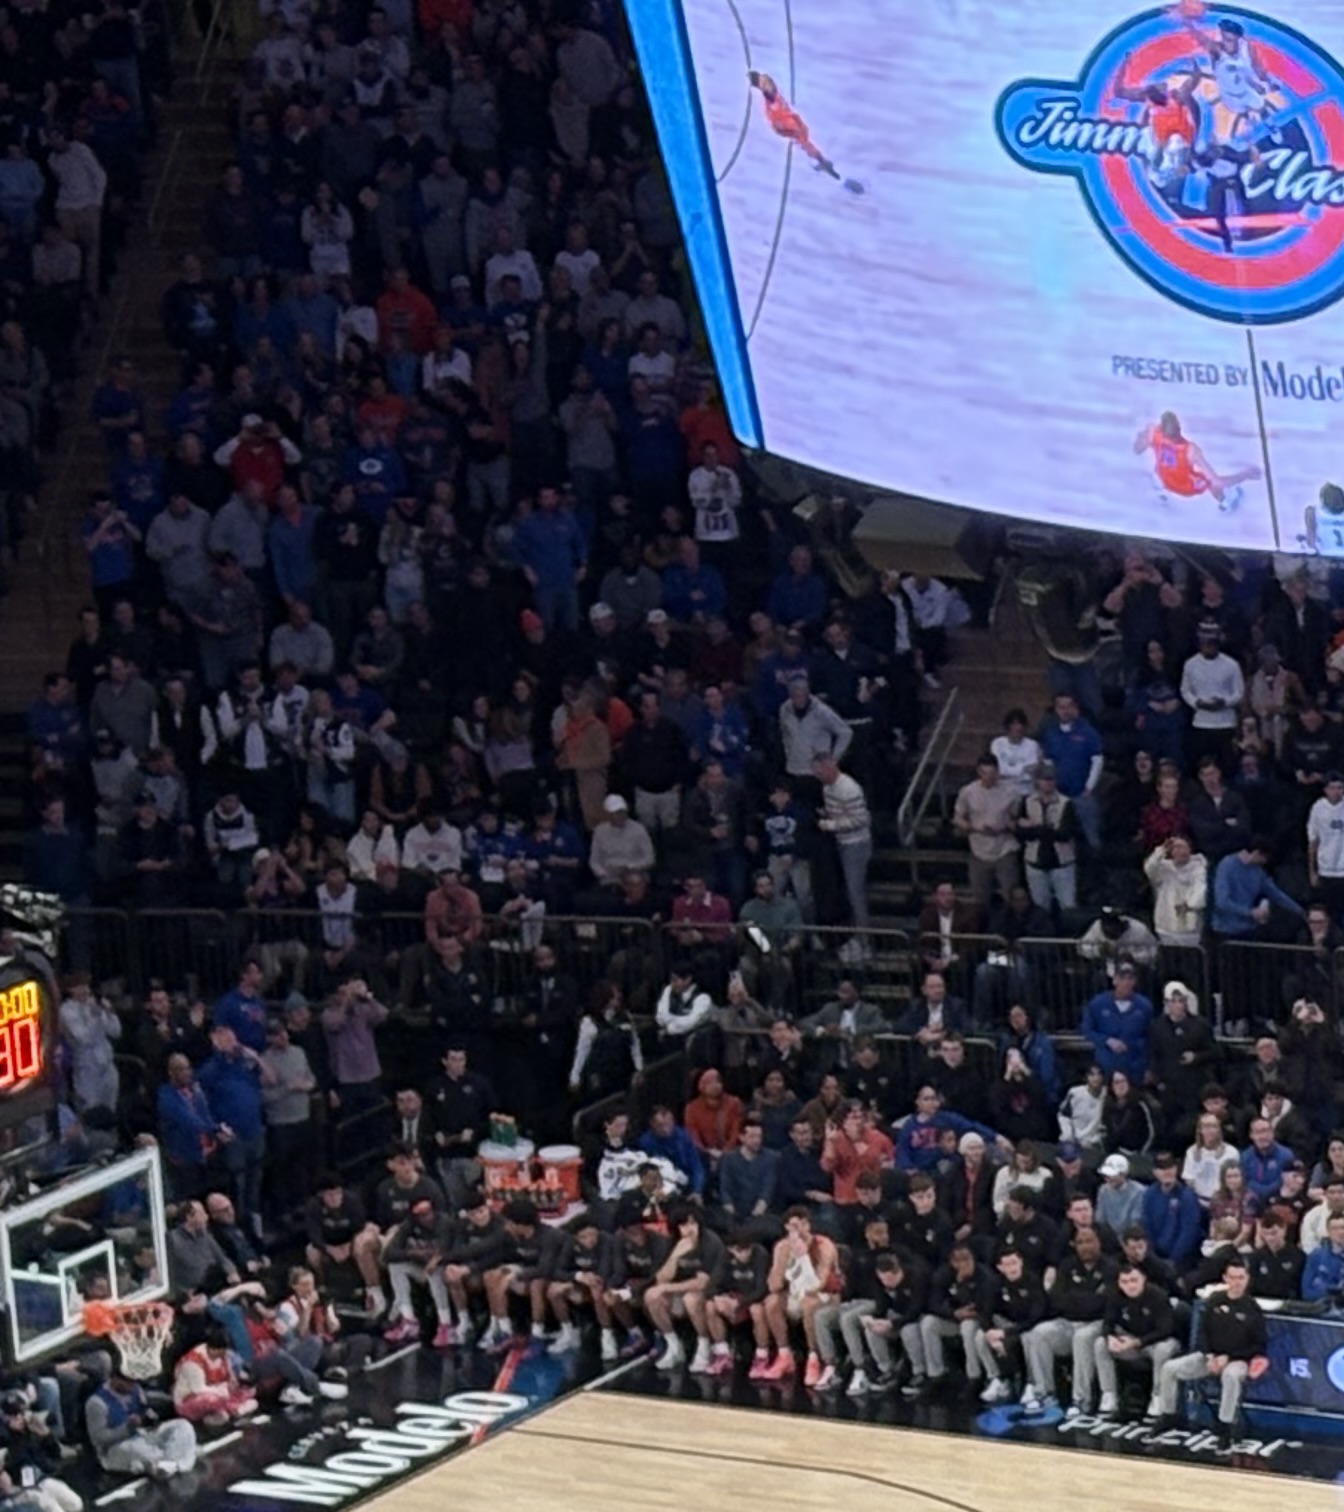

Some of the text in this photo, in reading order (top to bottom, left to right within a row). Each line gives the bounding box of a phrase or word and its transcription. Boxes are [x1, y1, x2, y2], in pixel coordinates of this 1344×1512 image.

[1019, 101, 1155, 158] Jimm
[1112, 355, 1219, 385] PRESENTED
[1225, 365, 1248, 387] BY
[226, 1391, 529, 1506] Modelo
